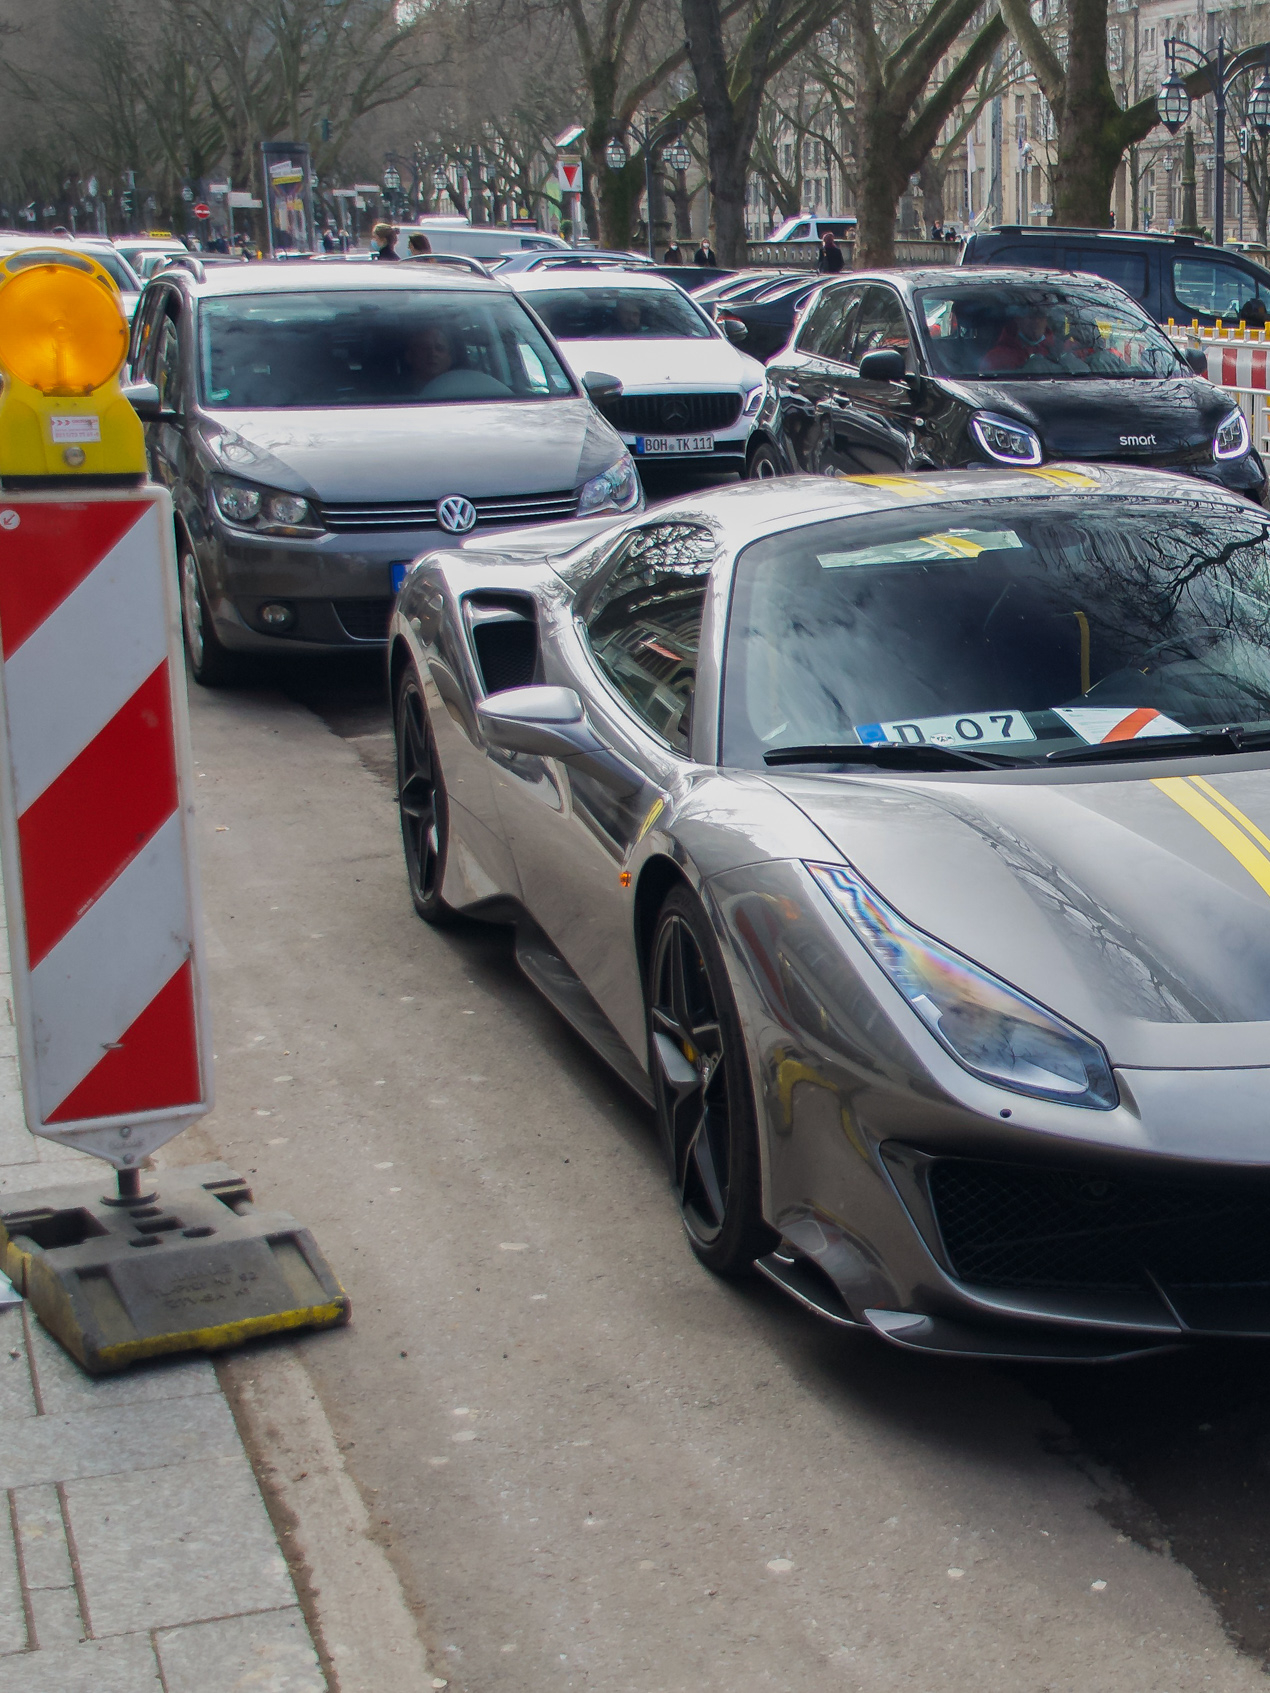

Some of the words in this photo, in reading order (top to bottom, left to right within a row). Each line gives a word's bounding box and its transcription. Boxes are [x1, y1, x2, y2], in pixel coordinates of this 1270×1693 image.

[645, 438, 668, 452] BOH
[676, 438, 690, 451] TK
[693, 437, 713, 450] 111
[1119, 434, 1157, 446] smart
[956, 715, 1014, 741] 07
